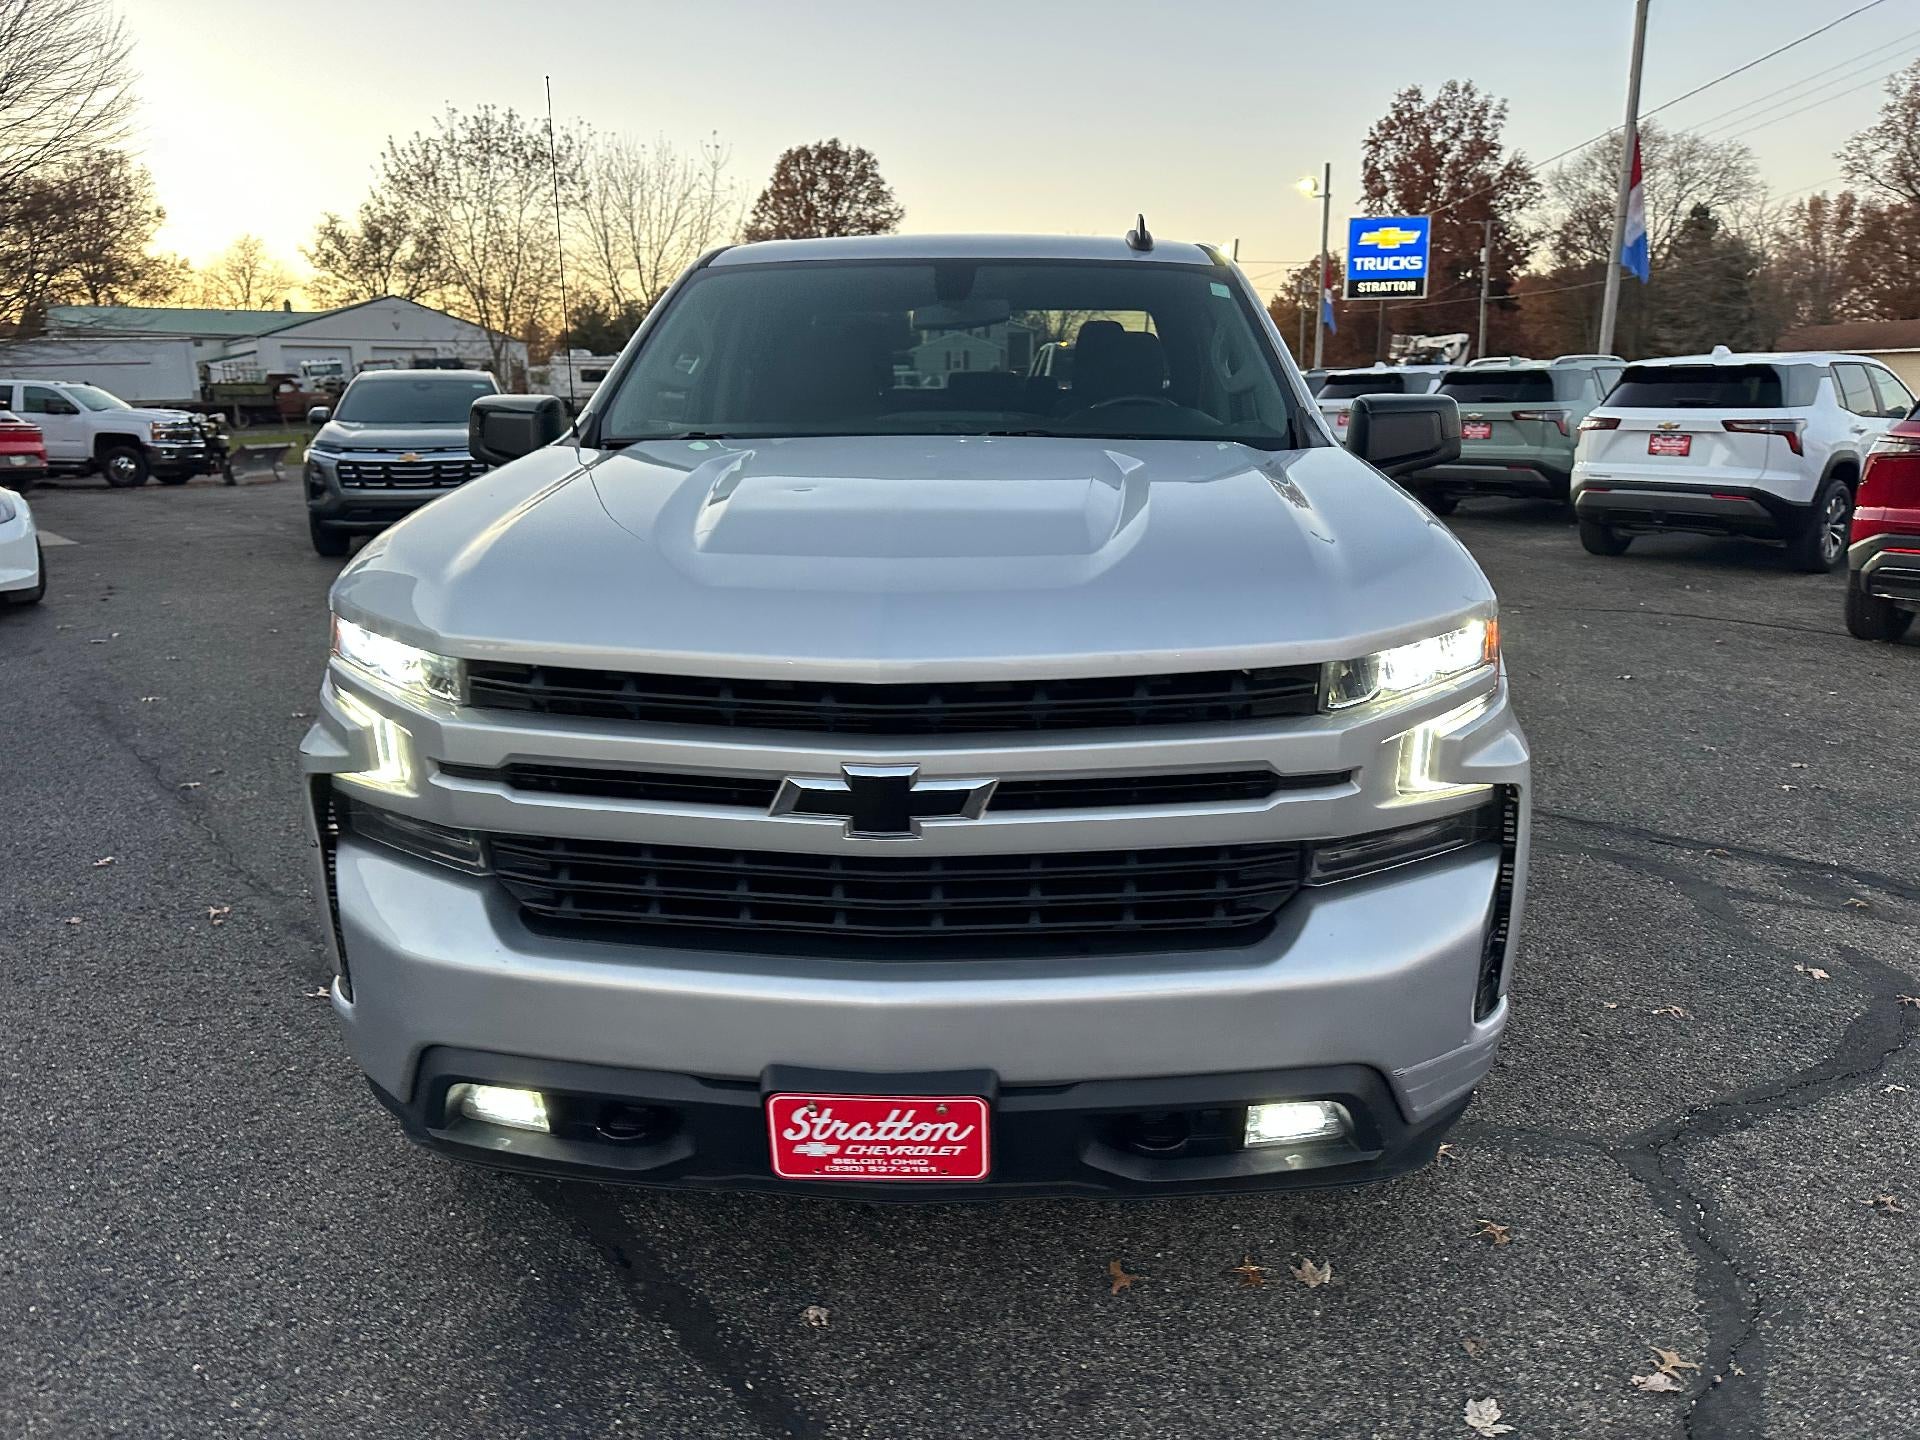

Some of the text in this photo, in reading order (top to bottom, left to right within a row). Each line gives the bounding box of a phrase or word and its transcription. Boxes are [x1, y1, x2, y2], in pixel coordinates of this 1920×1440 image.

[1353, 255, 1423, 271] TRUCKS
[1357, 280, 1416, 292] STRATTON
[782, 1106, 975, 1142] Stratton
[844, 1145, 967, 1156] CHEVROLET
